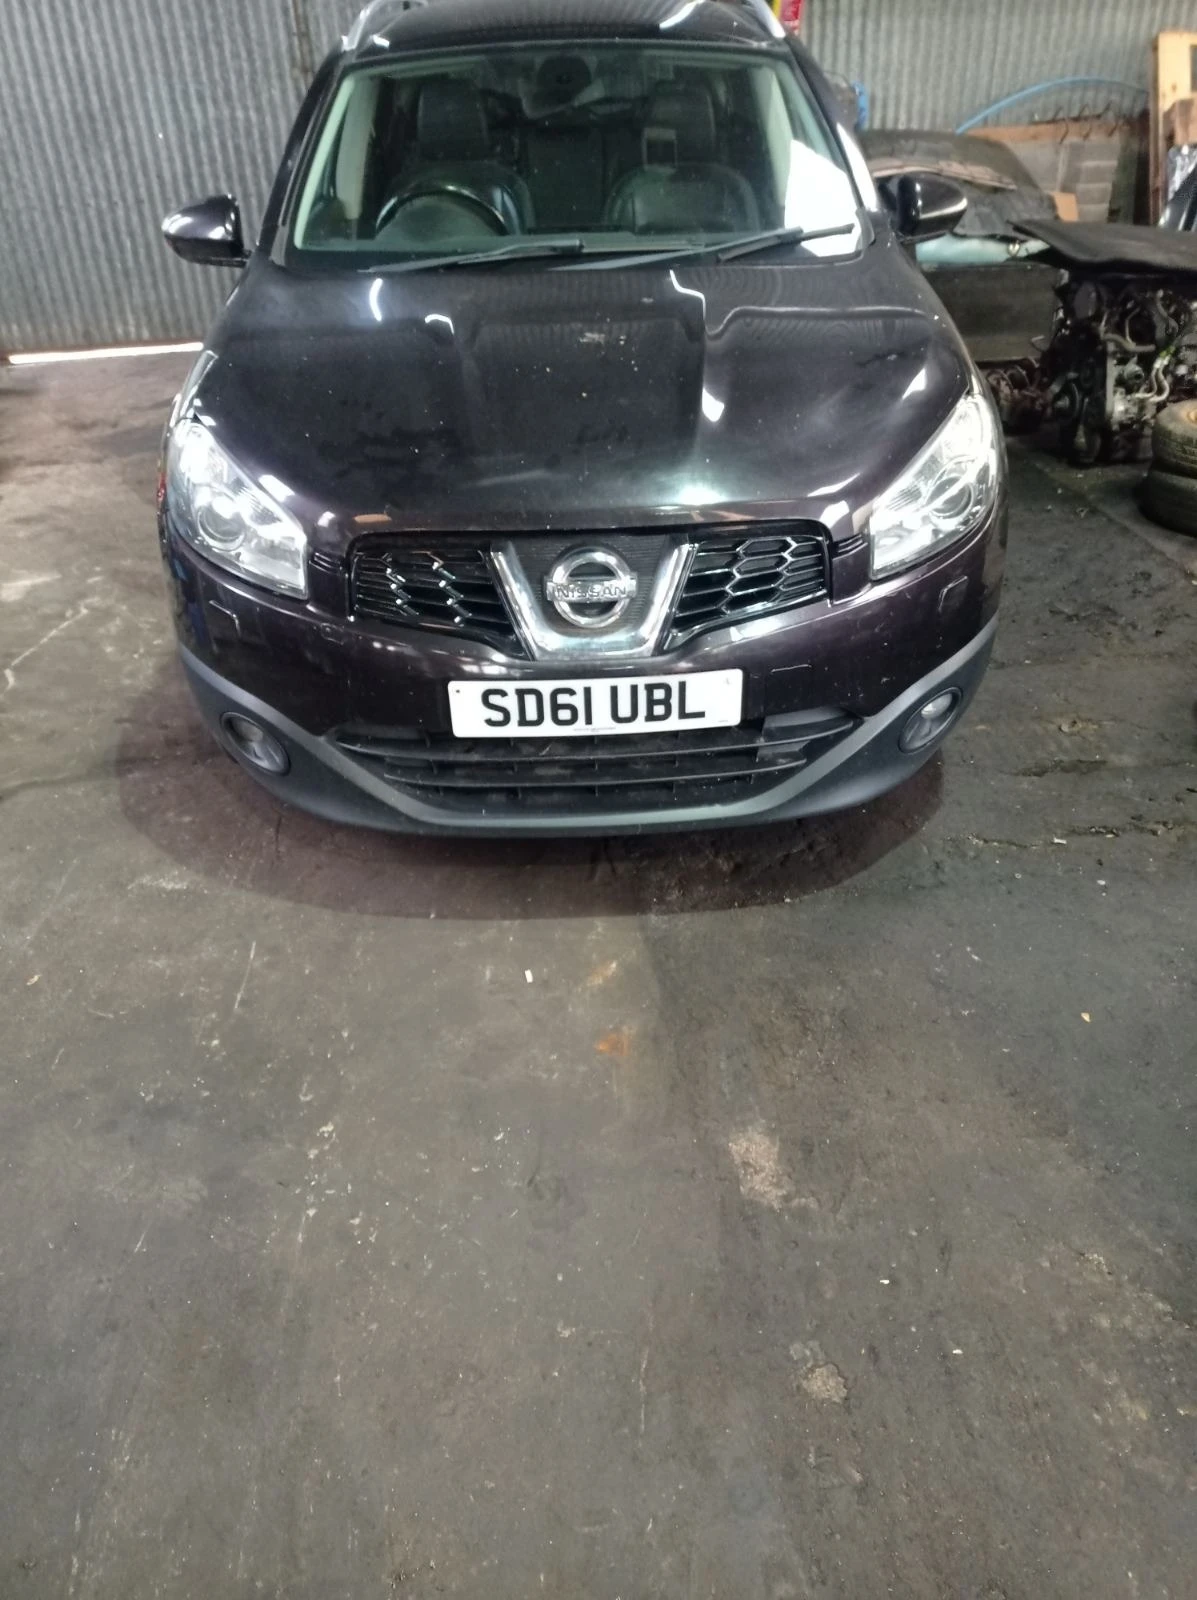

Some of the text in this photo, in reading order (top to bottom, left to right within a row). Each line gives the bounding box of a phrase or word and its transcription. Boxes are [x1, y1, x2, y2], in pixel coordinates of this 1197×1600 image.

[556, 584, 627, 598] NISSAN
[481, 681, 706, 727] SD61 UBL
